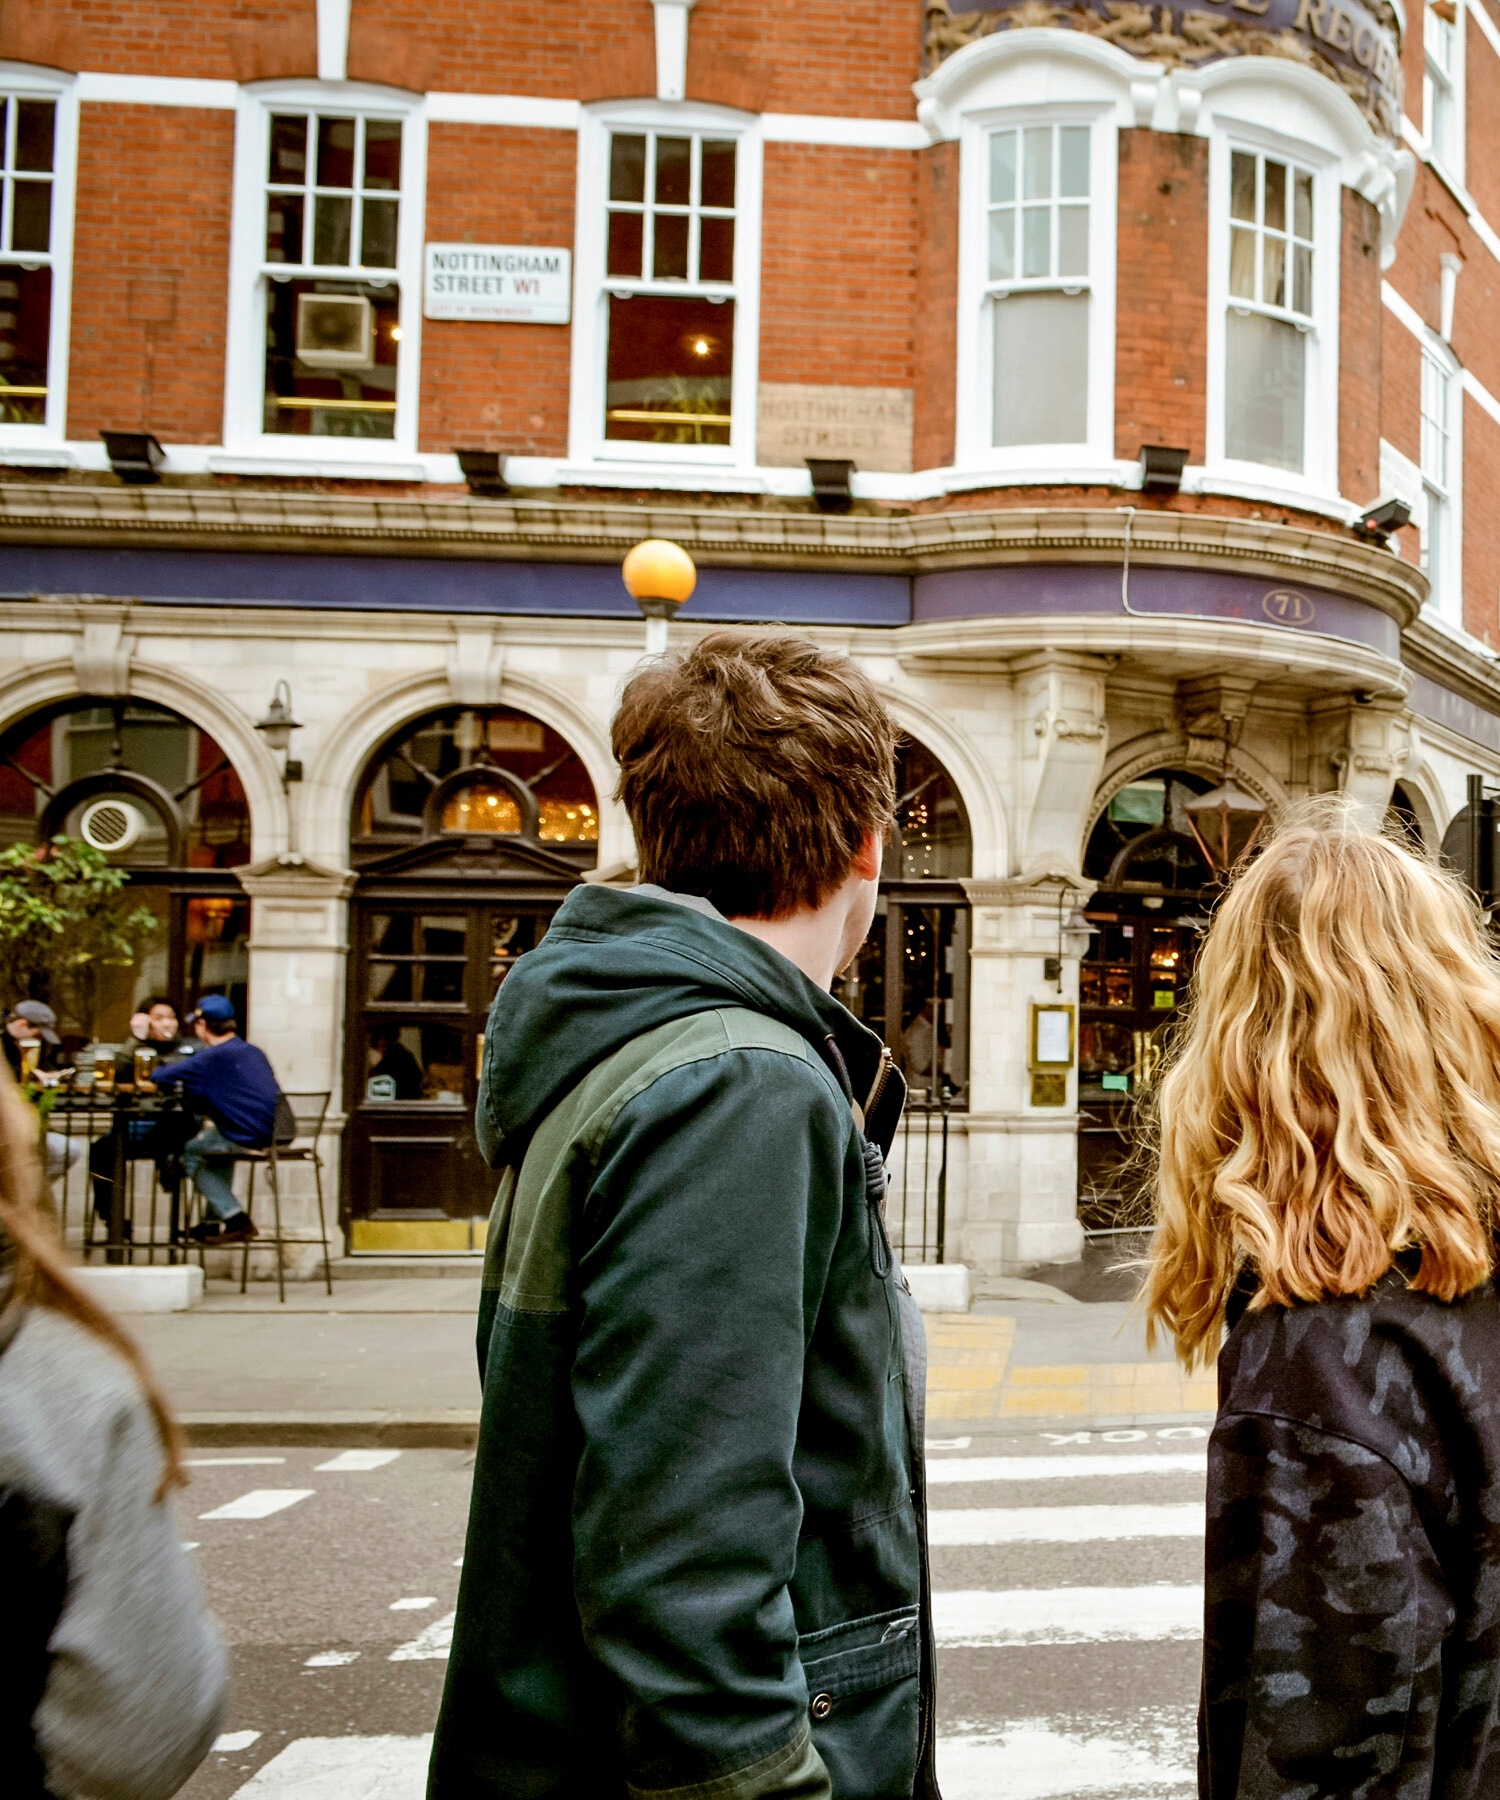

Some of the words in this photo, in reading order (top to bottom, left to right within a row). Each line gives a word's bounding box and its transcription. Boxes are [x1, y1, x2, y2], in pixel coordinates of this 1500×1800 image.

[433, 253, 561, 274] NOTTINGHAM
[433, 274, 504, 296] STREET
[513, 278, 540, 296] W1
[1275, 594, 1303, 619] 71
[1039, 1426, 1209, 1446] OOK
